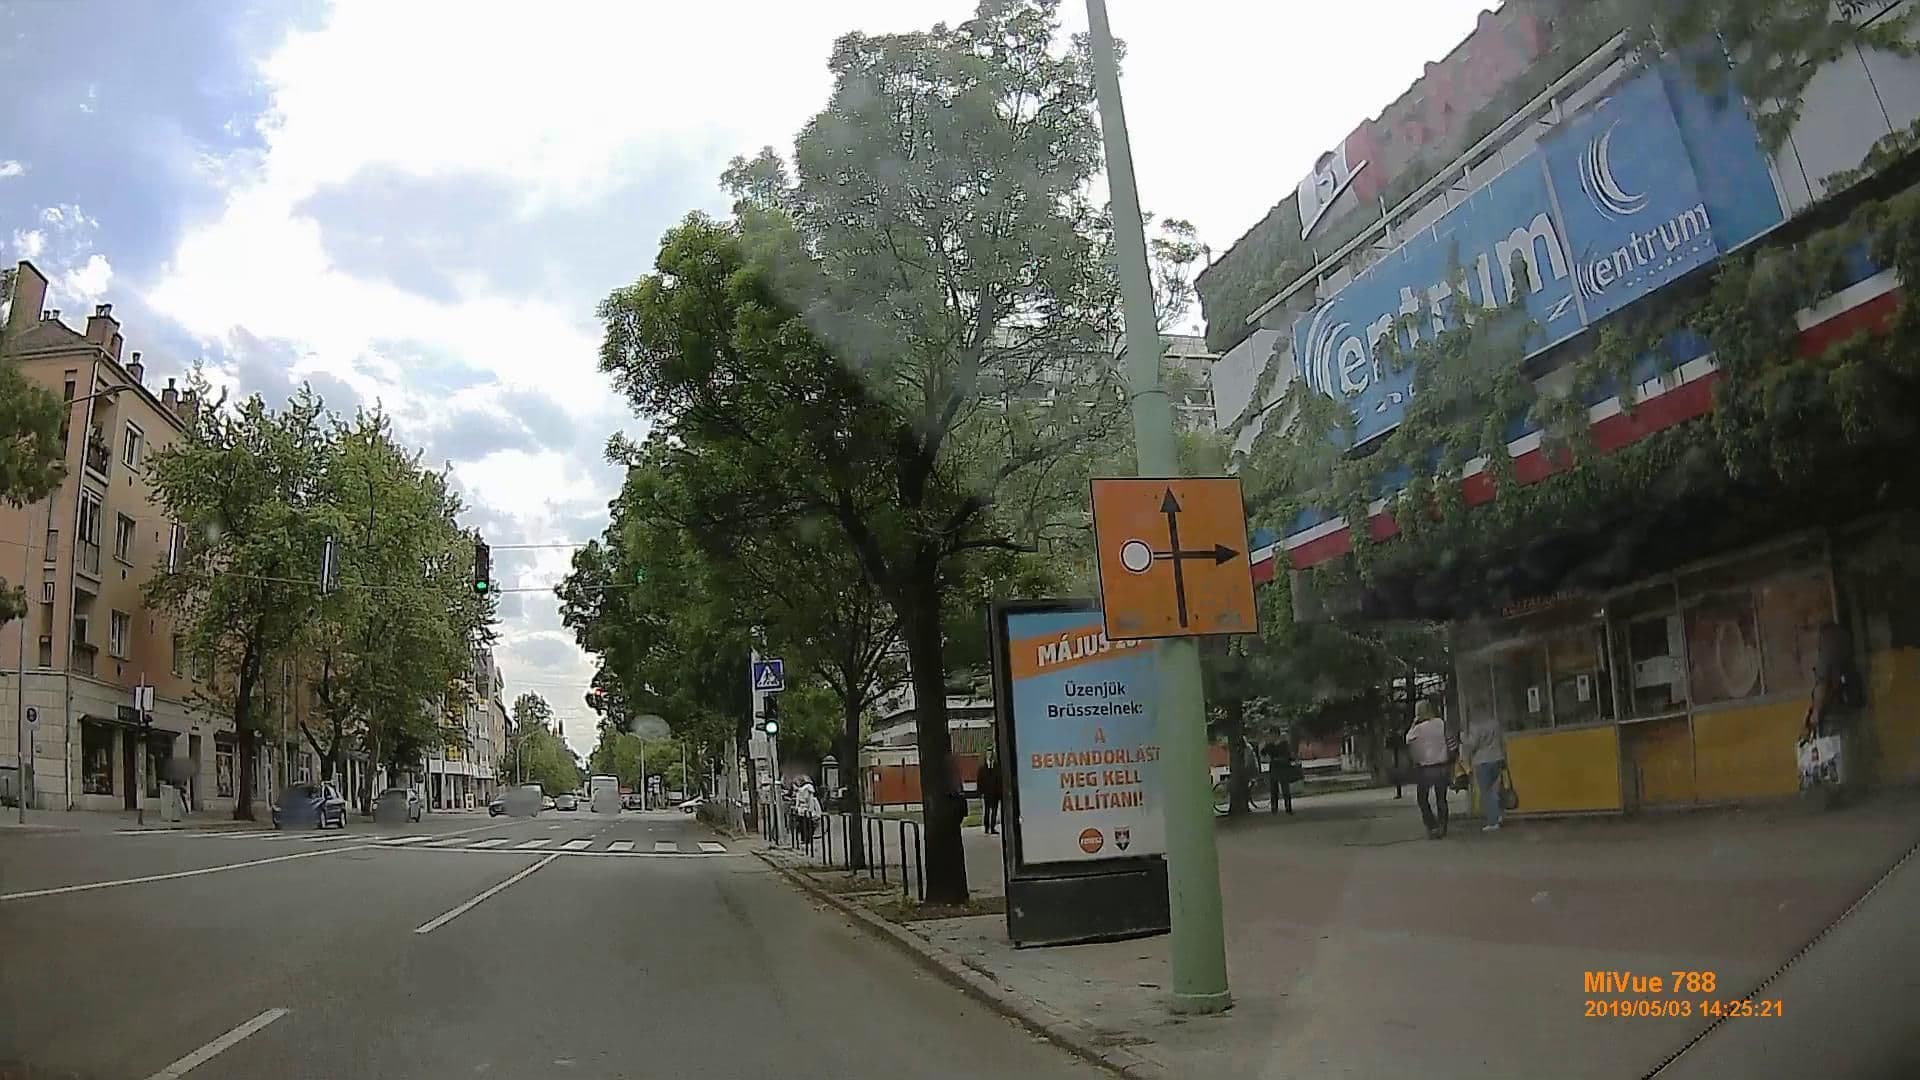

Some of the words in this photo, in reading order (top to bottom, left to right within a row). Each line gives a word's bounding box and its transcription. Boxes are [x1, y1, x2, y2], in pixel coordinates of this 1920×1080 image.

[1064, 680, 1126, 698] Üzenjük
[1047, 700, 1143, 718] Brüsszelnek:
[1094, 727, 1105, 744] A
[1060, 771, 1097, 788] MEG
[1103, 769, 1143, 786] KELL
[1062, 789, 1143, 812] ÁLLÍTANI!
